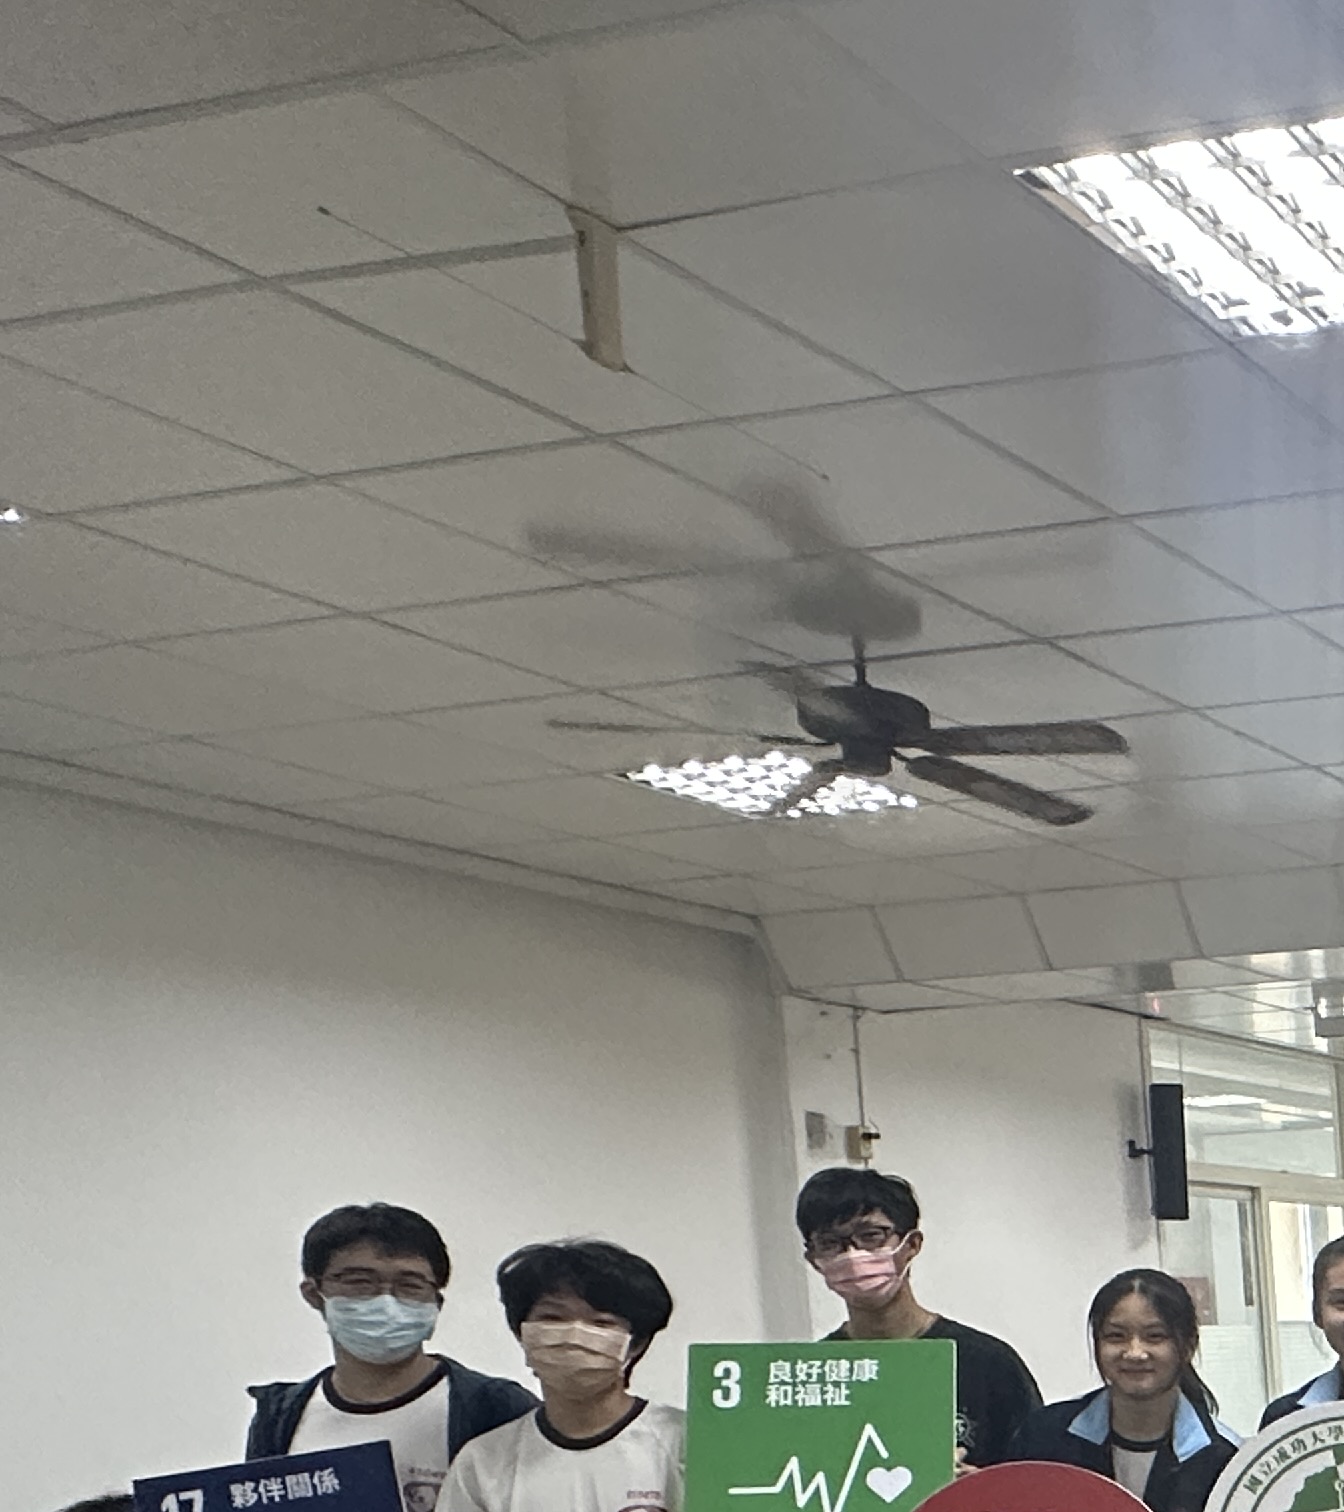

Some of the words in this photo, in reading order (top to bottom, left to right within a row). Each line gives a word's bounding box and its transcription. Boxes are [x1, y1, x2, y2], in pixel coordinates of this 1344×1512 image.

[712, 1360, 742, 1408] 3
[768, 1359, 879, 1383] 良好健康
[765, 1383, 851, 1407] 和福祉
[229, 1467, 340, 1509] 夥伴關係
